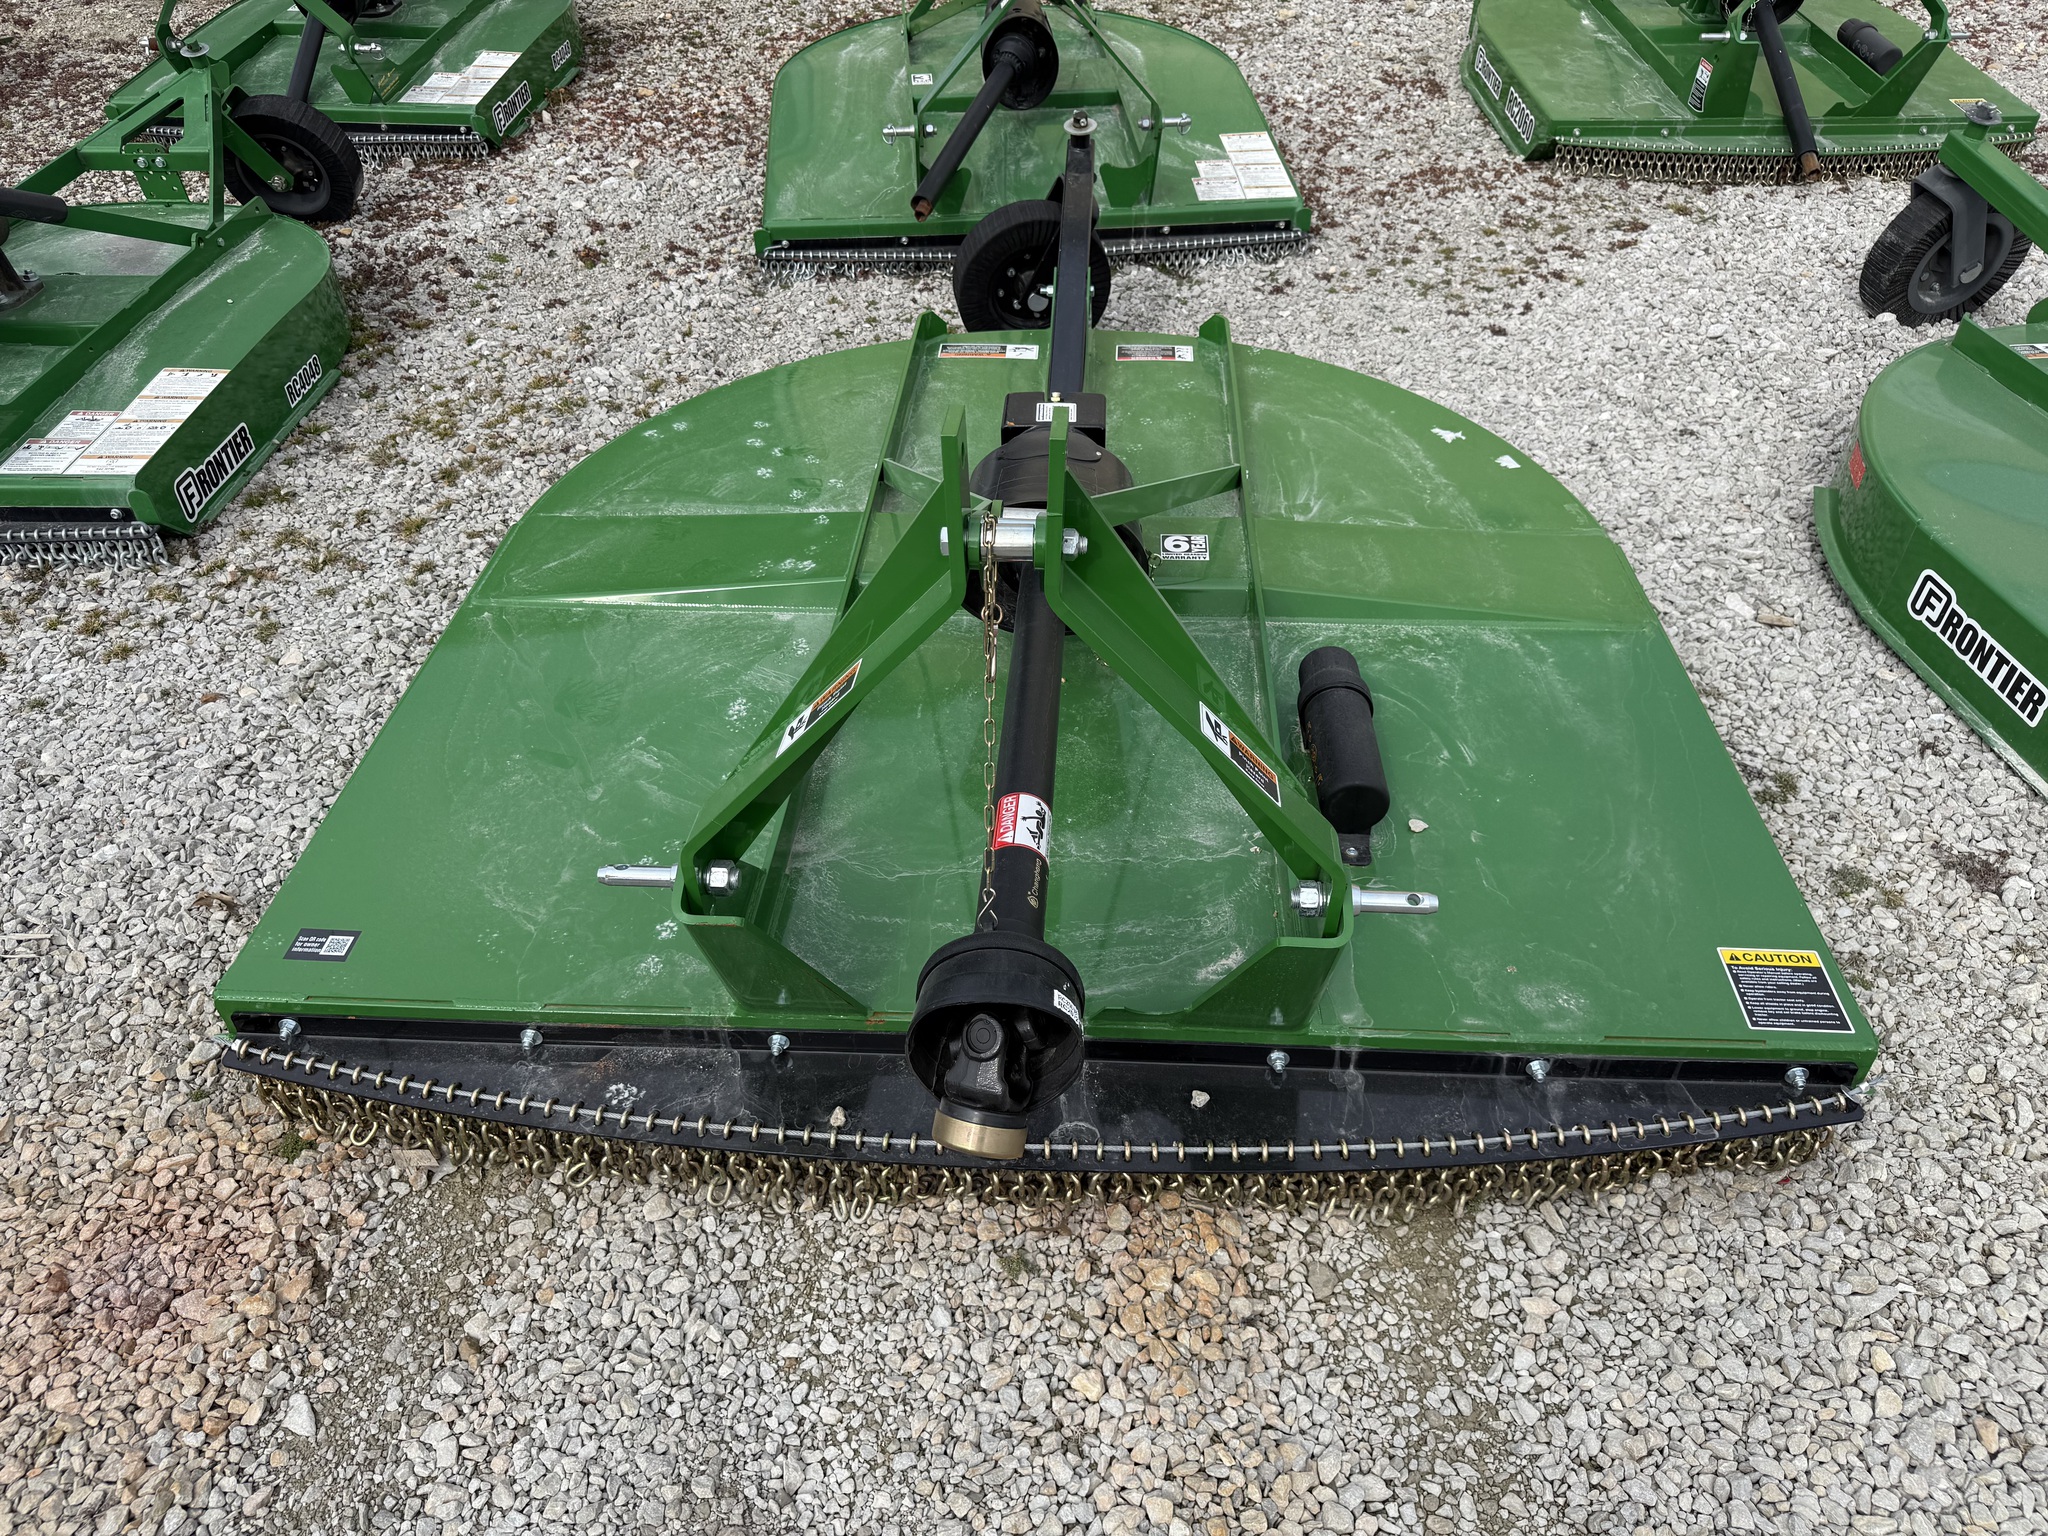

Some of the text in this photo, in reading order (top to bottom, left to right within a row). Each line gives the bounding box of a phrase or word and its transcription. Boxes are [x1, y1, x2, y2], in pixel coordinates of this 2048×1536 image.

[1476, 48, 1502, 96] FRONTIER
[494, 82, 531, 134] FRONTIER
[1506, 90, 1534, 142] RC2060
[286, 356, 322, 407] RC4048
[176, 424, 254, 521] FRONTIER
[1164, 536, 1206, 553] 6 YEAR
[1910, 574, 2046, 722] FRONTIER
[1236, 738, 1273, 780] WARNING
[1000, 795, 1017, 832] DANGER
[1741, 953, 1812, 963] CAUTION
